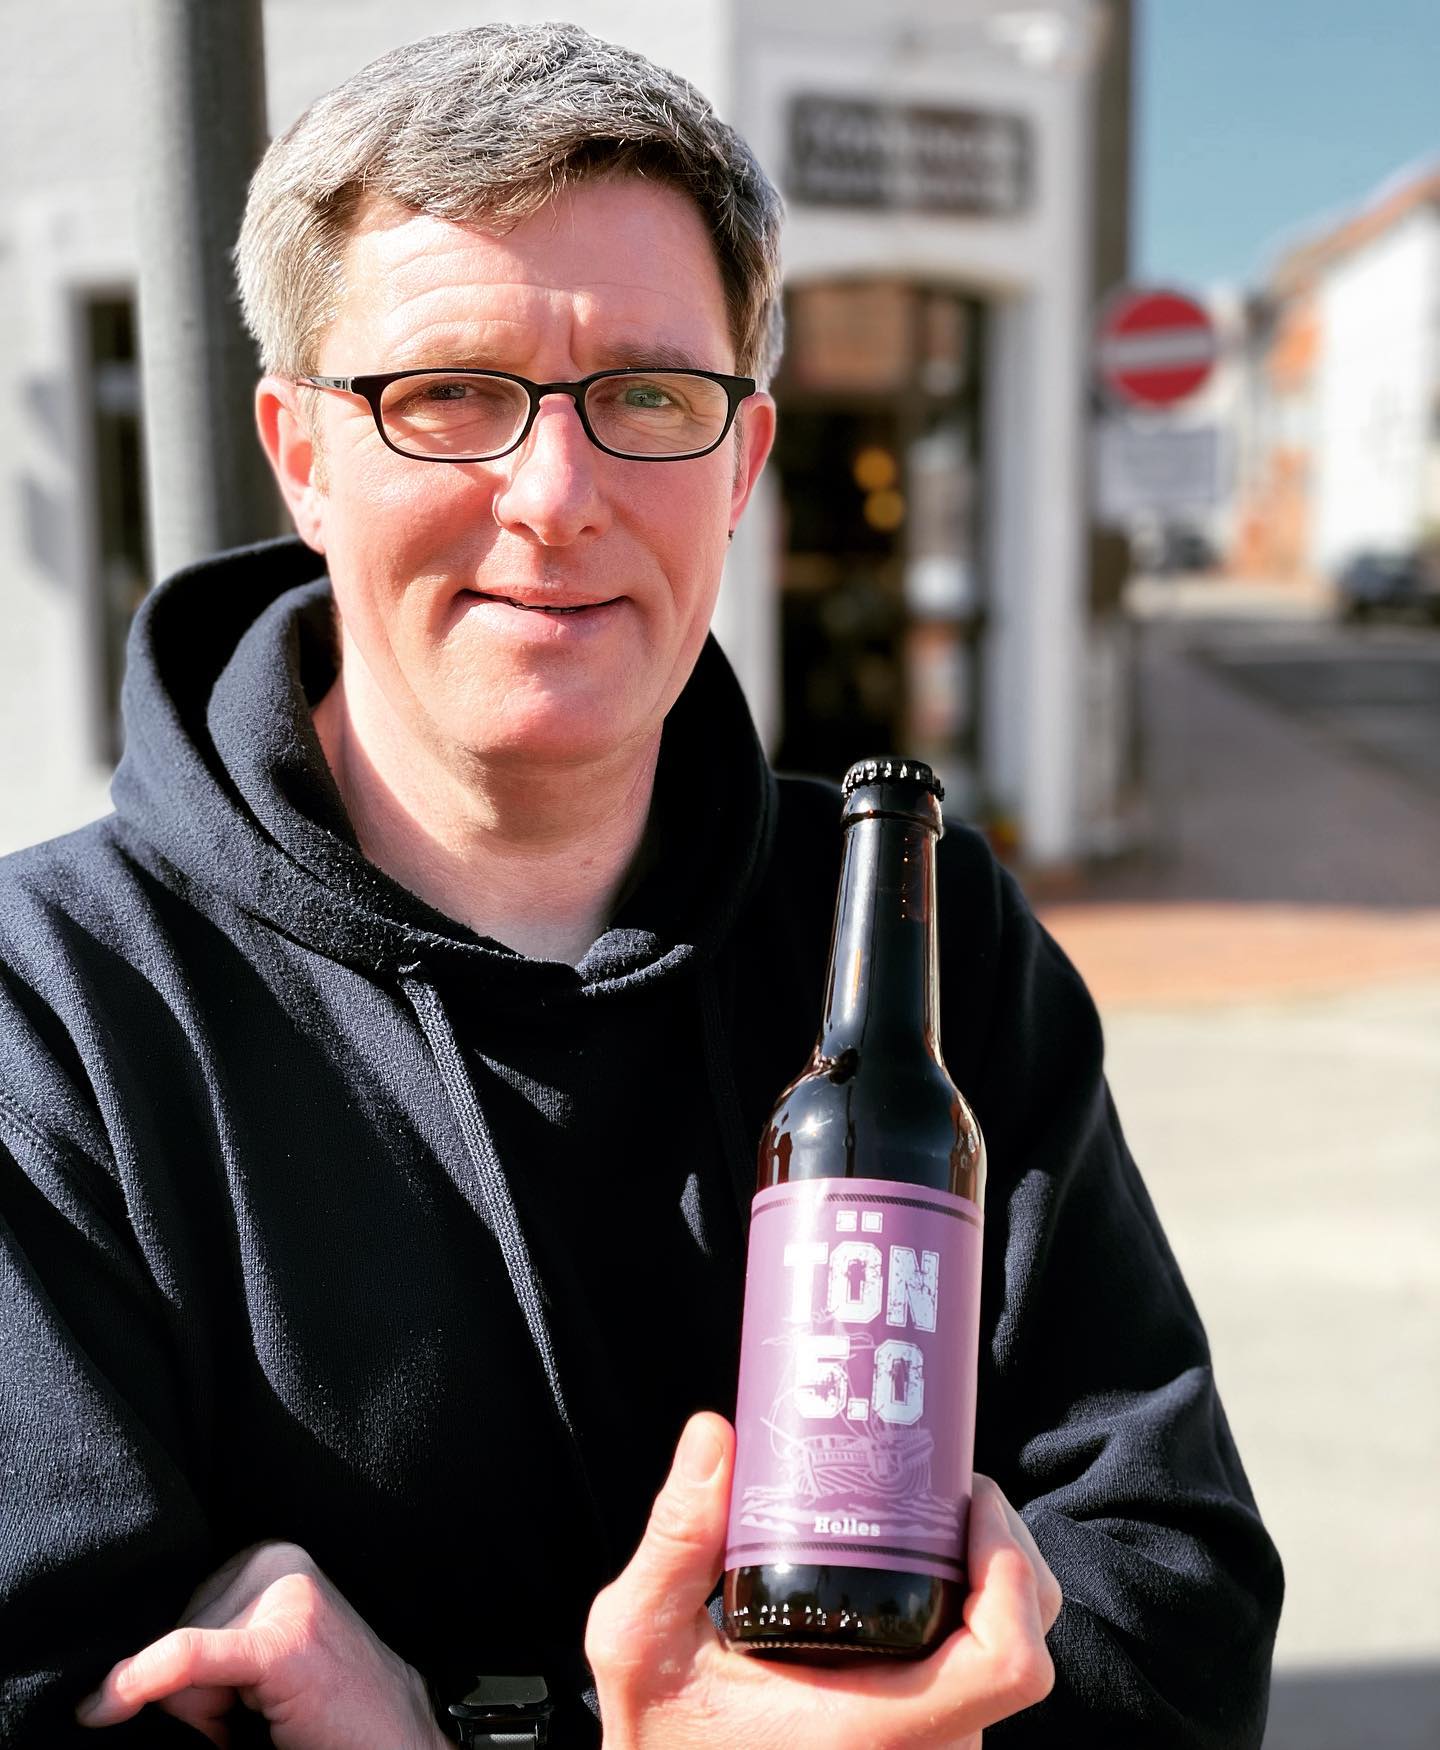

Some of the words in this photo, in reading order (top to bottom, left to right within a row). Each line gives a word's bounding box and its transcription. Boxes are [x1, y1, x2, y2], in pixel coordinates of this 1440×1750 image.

[784, 1211, 940, 1332] TÖN
[796, 1334, 924, 1425] 5.0
[814, 1516, 881, 1537] Helles
